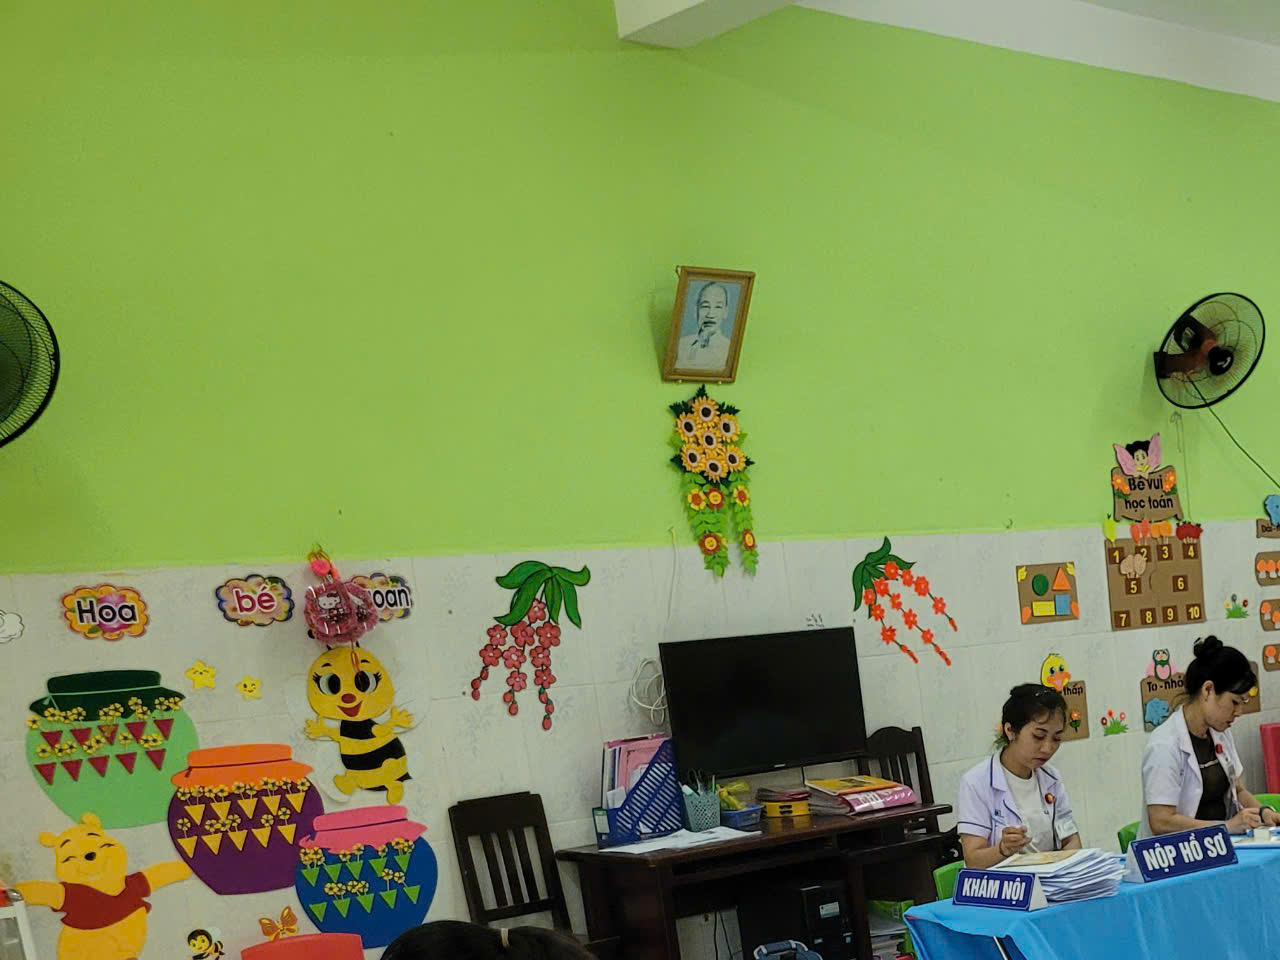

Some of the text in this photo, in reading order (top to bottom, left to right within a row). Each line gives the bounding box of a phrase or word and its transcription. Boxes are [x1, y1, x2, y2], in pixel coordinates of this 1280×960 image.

[1147, 475, 1163, 490] vui
[1125, 495, 1173, 512] học toán
[1113, 544, 1195, 563] 1 2 3 4
[1130, 577, 1185, 593] 5 6
[76, 585, 407, 624] Hoa bé oan
[1119, 605, 1200, 627] 7 8 9 10
[1142, 832, 1228, 873] NỘP HỒ SƠ
[962, 877, 1026, 905] KHÁM NỘI
